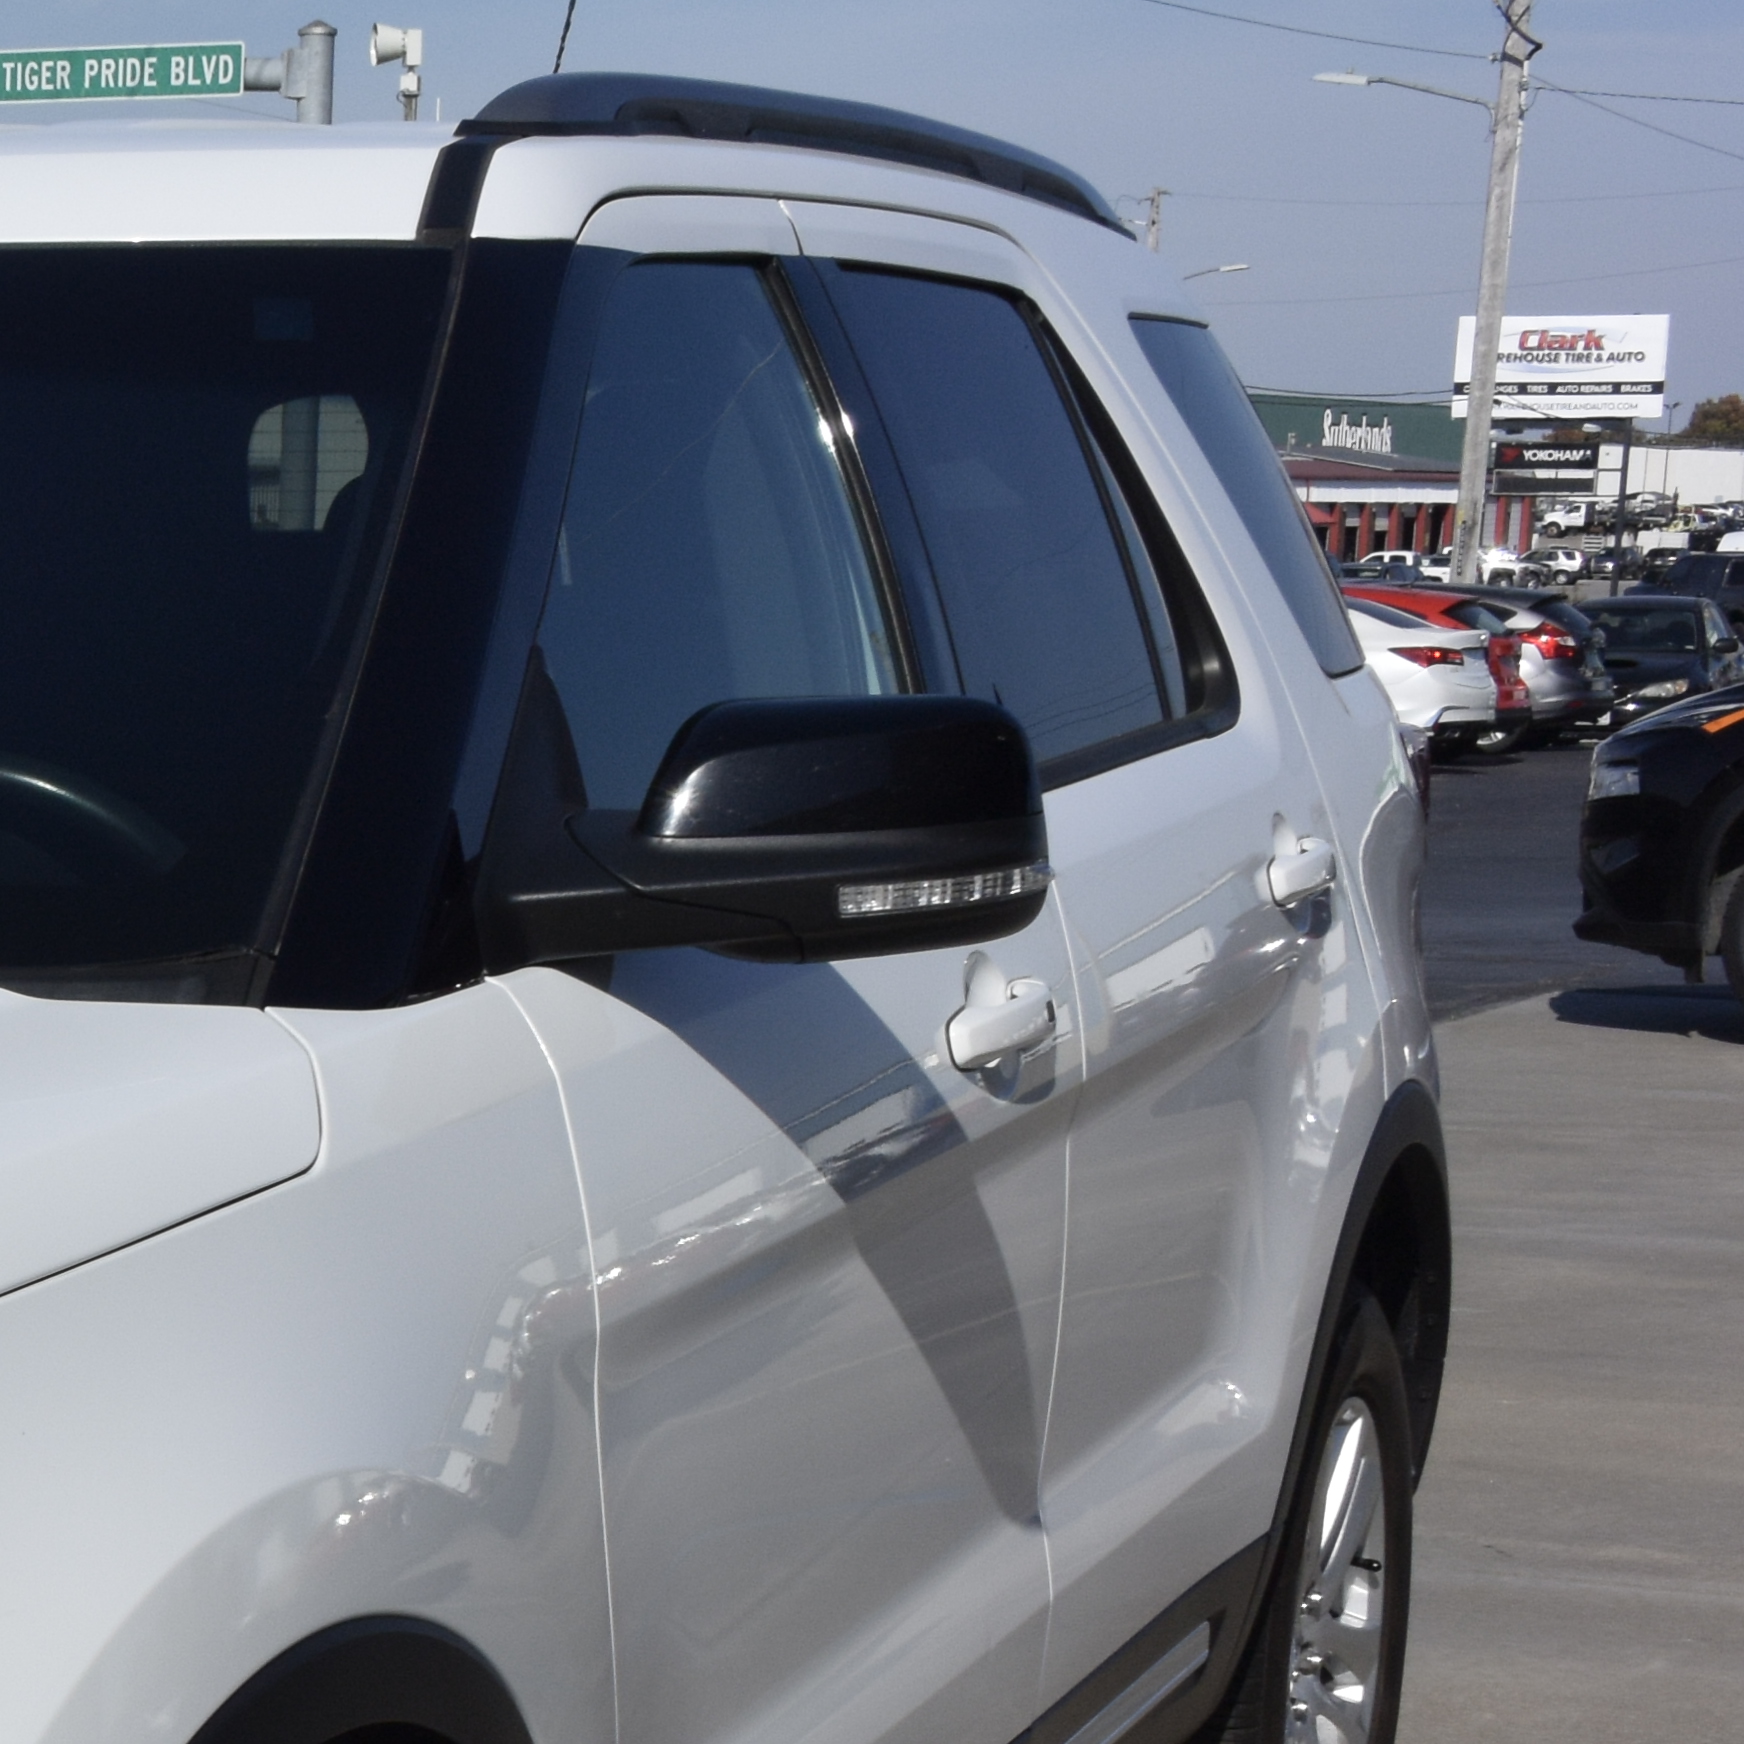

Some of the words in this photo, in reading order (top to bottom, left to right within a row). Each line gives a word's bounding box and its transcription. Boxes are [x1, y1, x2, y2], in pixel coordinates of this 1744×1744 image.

[2, 60, 71, 91] TIGER
[84, 57, 157, 88] PRIDE
[170, 54, 233, 85] BLVD
[1518, 329, 1606, 351] Clark
[1497, 352, 1561, 363] REHOUSE
[1564, 352, 1593, 362] TIRE
[1594, 352, 1603, 362] &
[1606, 351, 1646, 362] AUTO
[1526, 385, 1548, 393] TIRES
[1555, 385, 1579, 393] AUTO
[1580, 384, 1613, 393] REPAIRS
[1620, 384, 1653, 393] BRAKES
[1322, 408, 1391, 452] Sutherlands
[1523, 449, 1592, 461] YOKOHAMA
